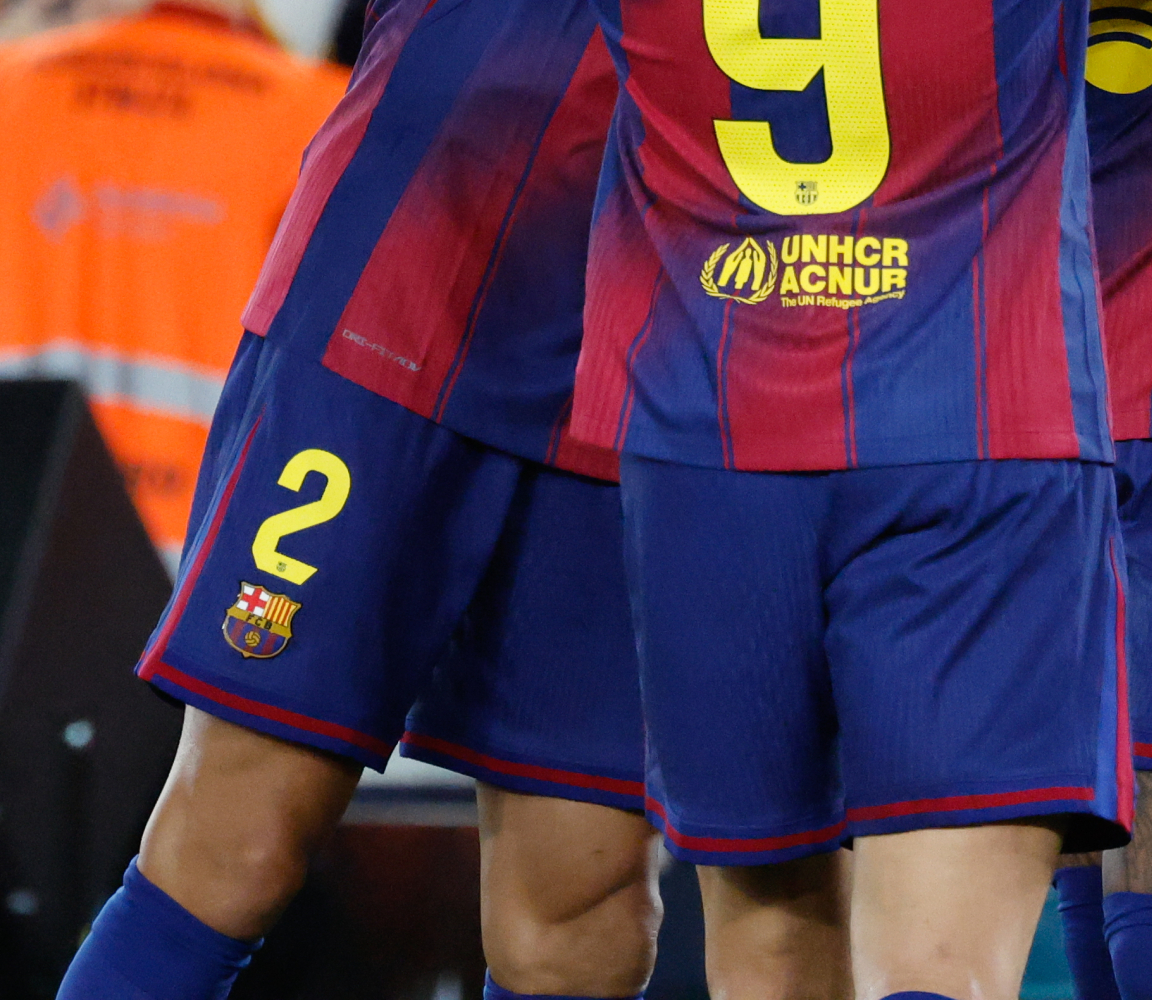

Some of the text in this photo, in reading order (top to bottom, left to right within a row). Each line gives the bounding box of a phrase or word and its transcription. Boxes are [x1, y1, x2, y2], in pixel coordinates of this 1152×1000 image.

[780, 234, 909, 267] UNHCR
[780, 264, 909, 296] ACNUR
[781, 290, 906, 310] The UN Refugee Agency
[252, 448, 352, 586] 2
[245, 614, 273, 630] FCB
